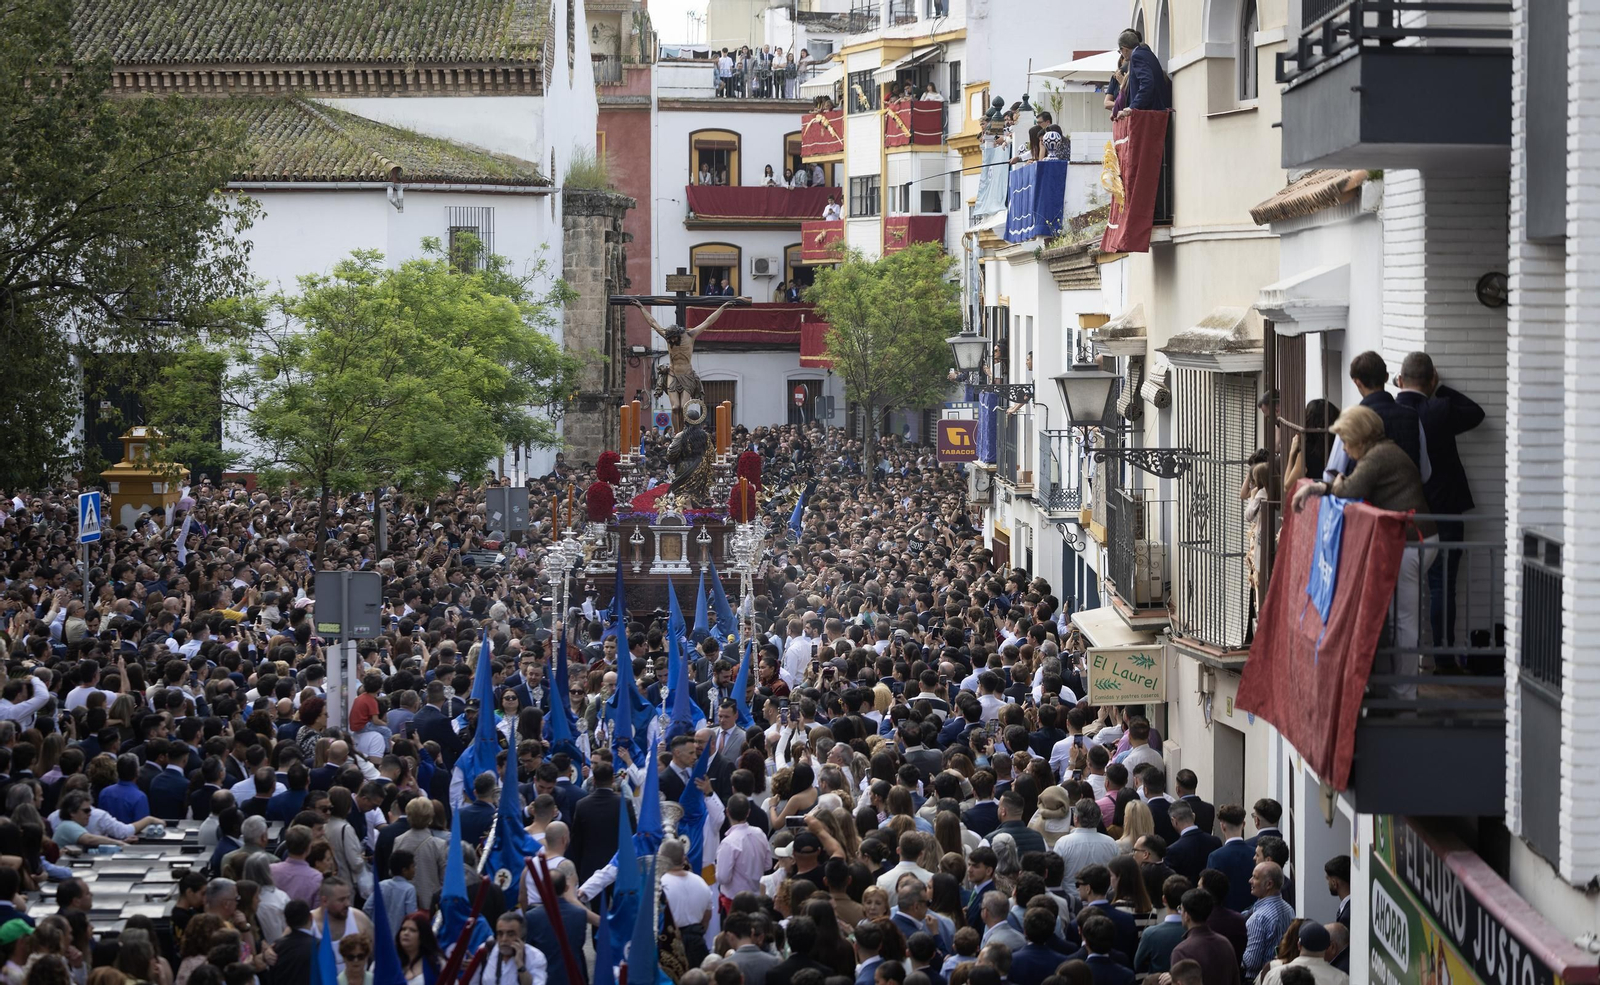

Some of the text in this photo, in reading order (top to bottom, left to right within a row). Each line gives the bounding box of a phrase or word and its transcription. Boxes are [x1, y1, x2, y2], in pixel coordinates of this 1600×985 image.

[1093, 655, 1158, 690] El Laurel
[1406, 823, 1421, 894] EL
[1423, 841, 1466, 946] EURO
[1375, 889, 1407, 965] AHORRA
